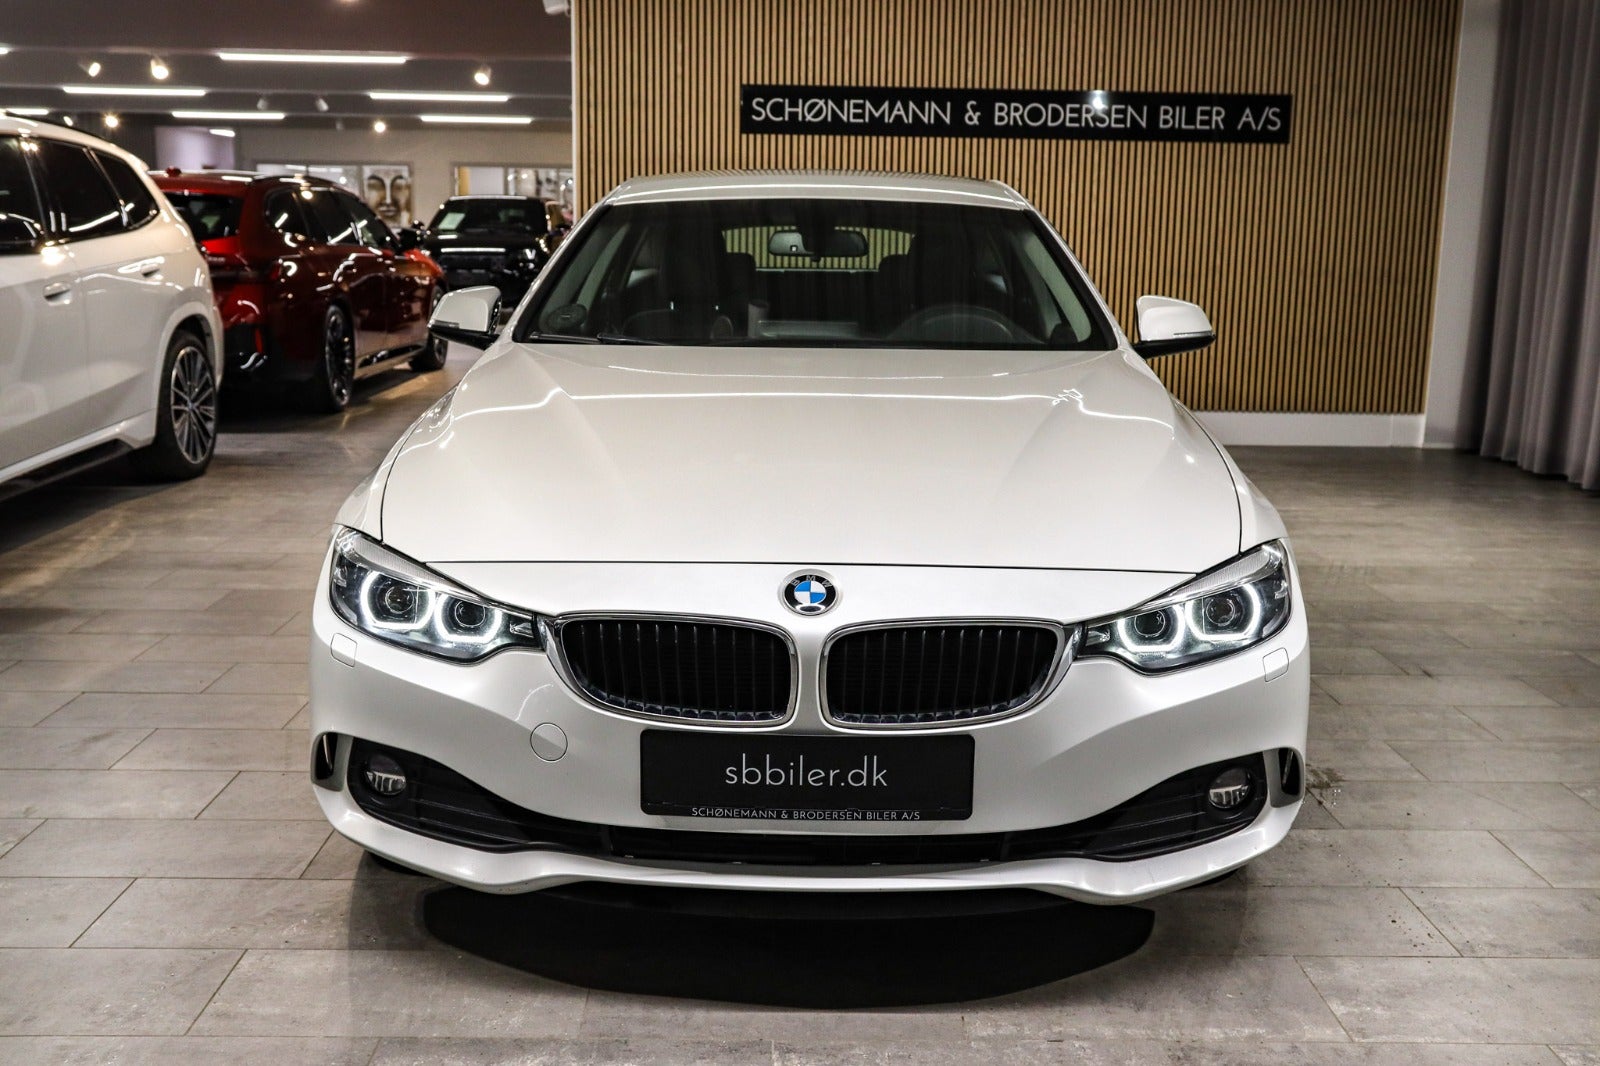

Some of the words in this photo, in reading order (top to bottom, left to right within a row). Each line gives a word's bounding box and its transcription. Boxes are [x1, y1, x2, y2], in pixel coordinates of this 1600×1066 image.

[751, 97, 951, 125] SCHØNEMANN
[964, 101, 981, 125] &
[994, 101, 1147, 128] BRODERSEN
[1159, 105, 1225, 130] BILER
[1237, 107, 1282, 131] A/S
[790, 575, 833, 588] BMW
[725, 752, 888, 787] sbbiler.dk
[691, 807, 777, 819] SCHØNEMANN
[780, 810, 789, 820] &
[792, 810, 862, 820] BRODERSEN
[865, 811, 898, 821] BILER
[901, 811, 921, 821] A/S
